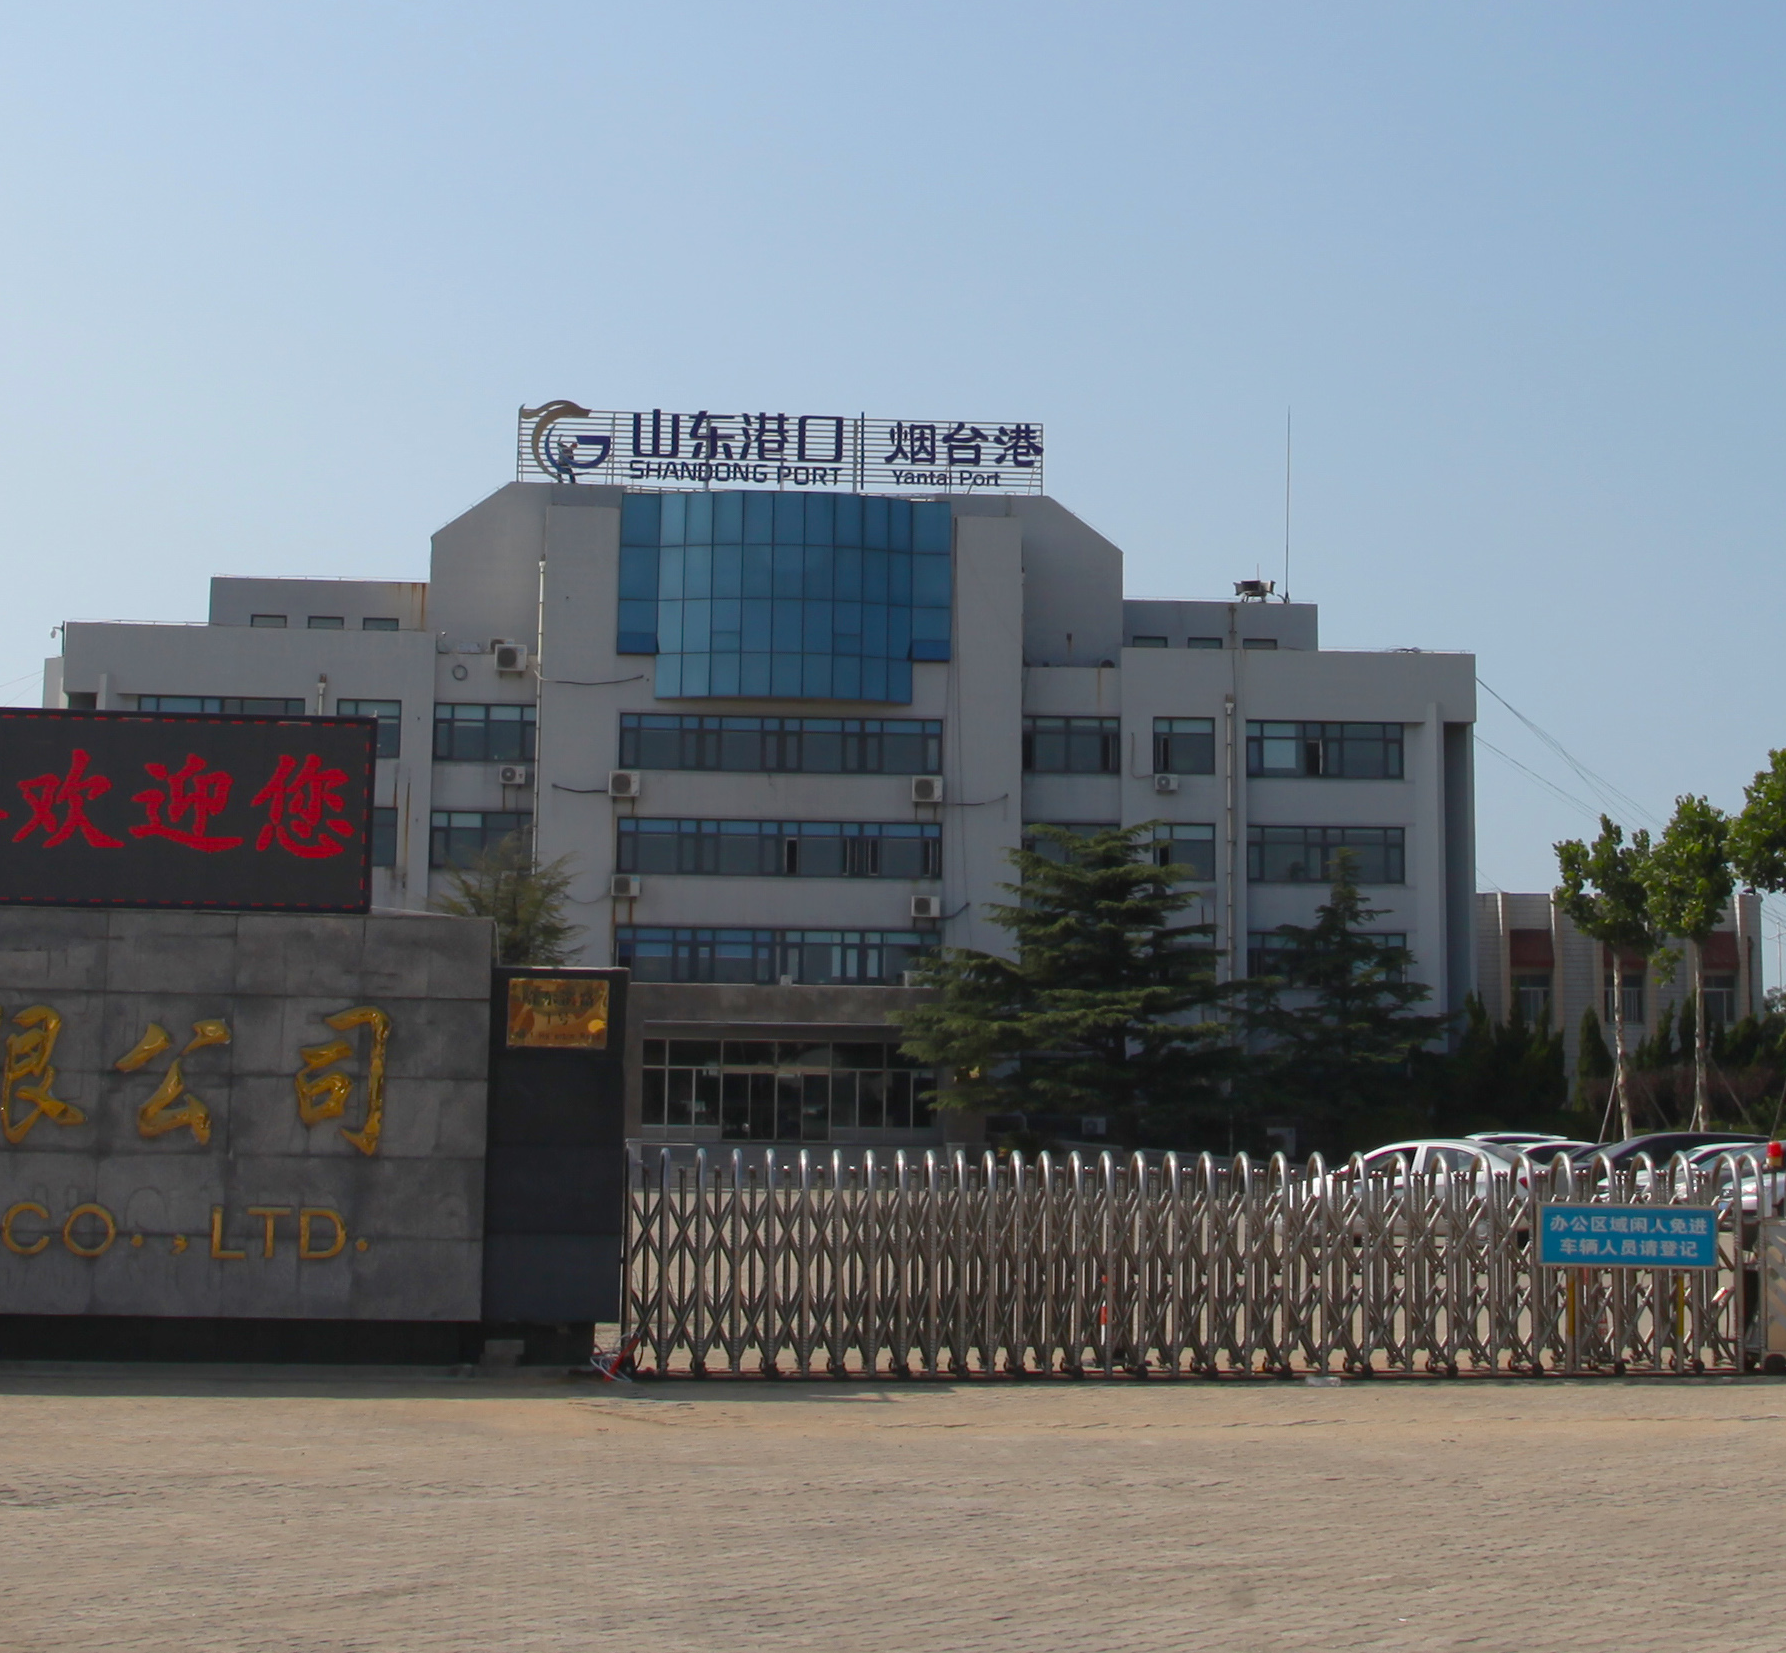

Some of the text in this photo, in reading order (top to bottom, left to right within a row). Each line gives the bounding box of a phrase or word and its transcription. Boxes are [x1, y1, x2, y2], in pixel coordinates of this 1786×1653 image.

[633, 408, 845, 463] 山东港口
[884, 421, 1045, 469] 烟台港
[628, 459, 845, 487] SHANDONG PORT
[890, 468, 1002, 488] Yantai Port
[1550, 1214, 1707, 1235] 办公区域闲人免进
[1559, 1237, 1699, 1258] 车辆人员请登记
